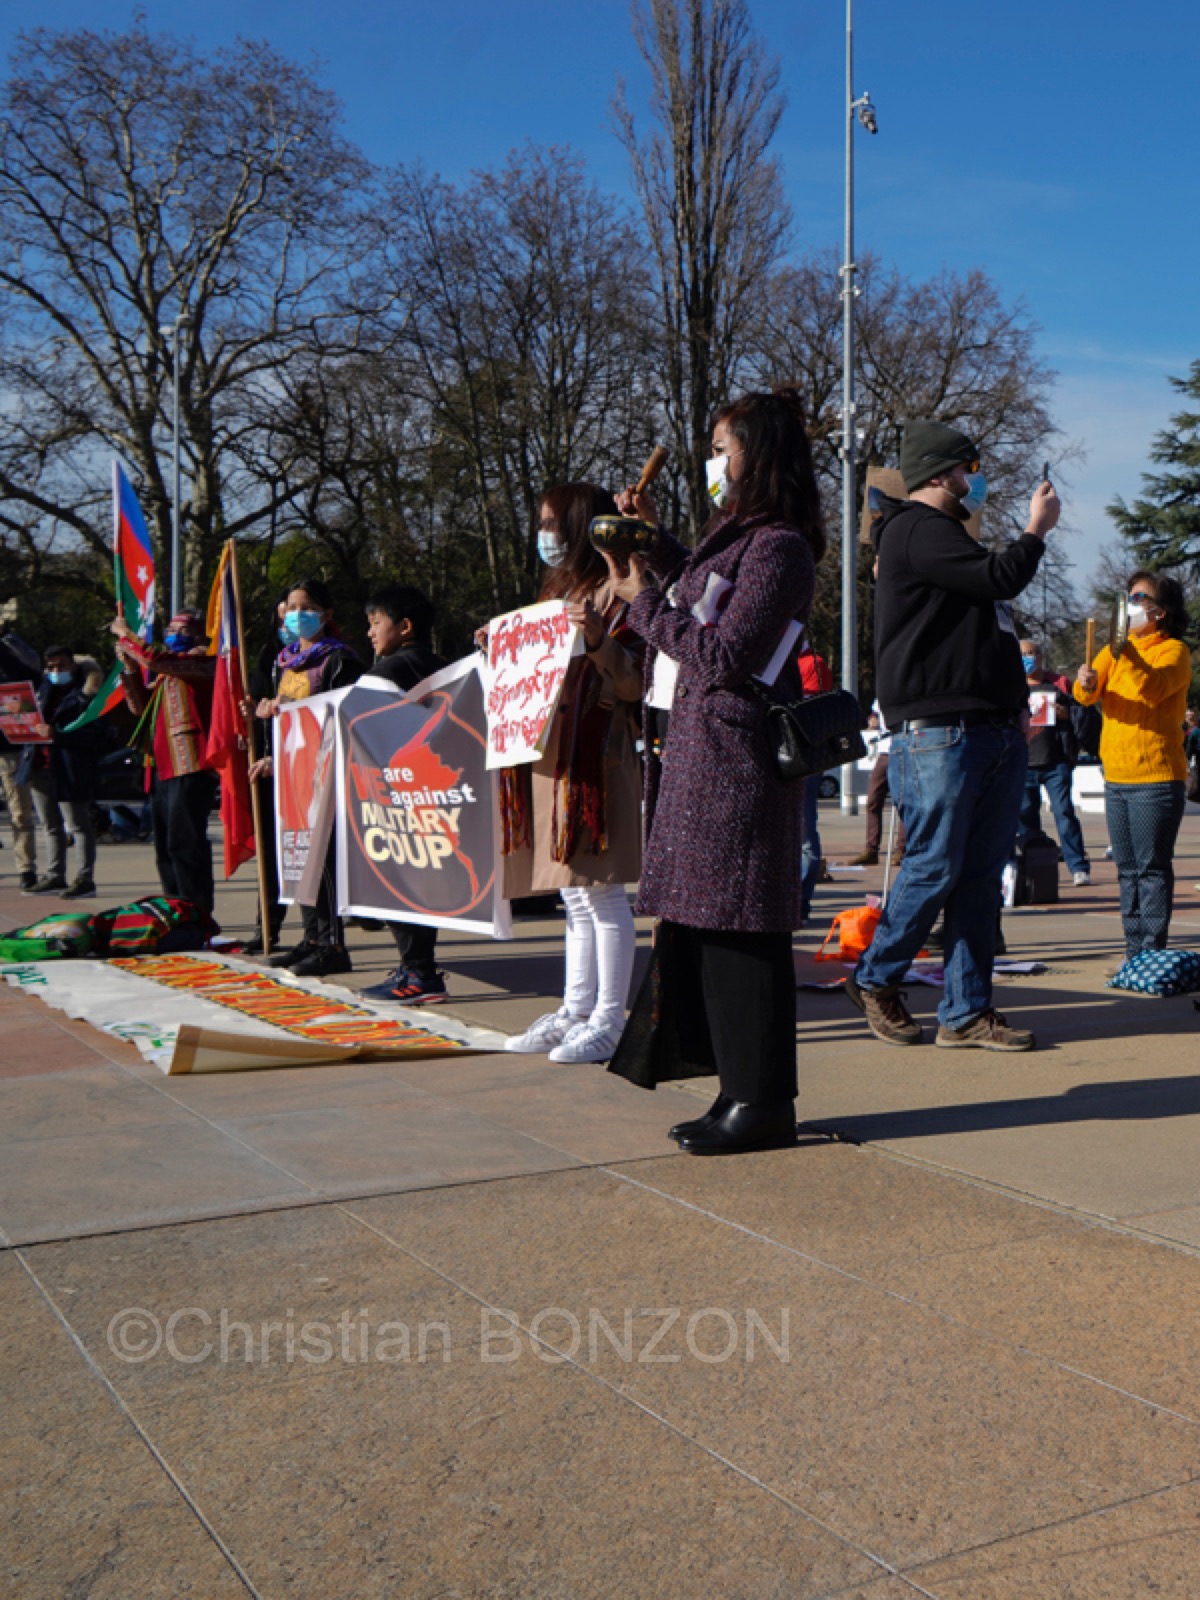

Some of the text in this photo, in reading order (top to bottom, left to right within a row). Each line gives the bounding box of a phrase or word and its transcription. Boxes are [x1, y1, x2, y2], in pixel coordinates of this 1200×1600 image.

[351, 763, 414, 806] WE are
[390, 783, 477, 810] against
[364, 827, 453, 869] COUP
